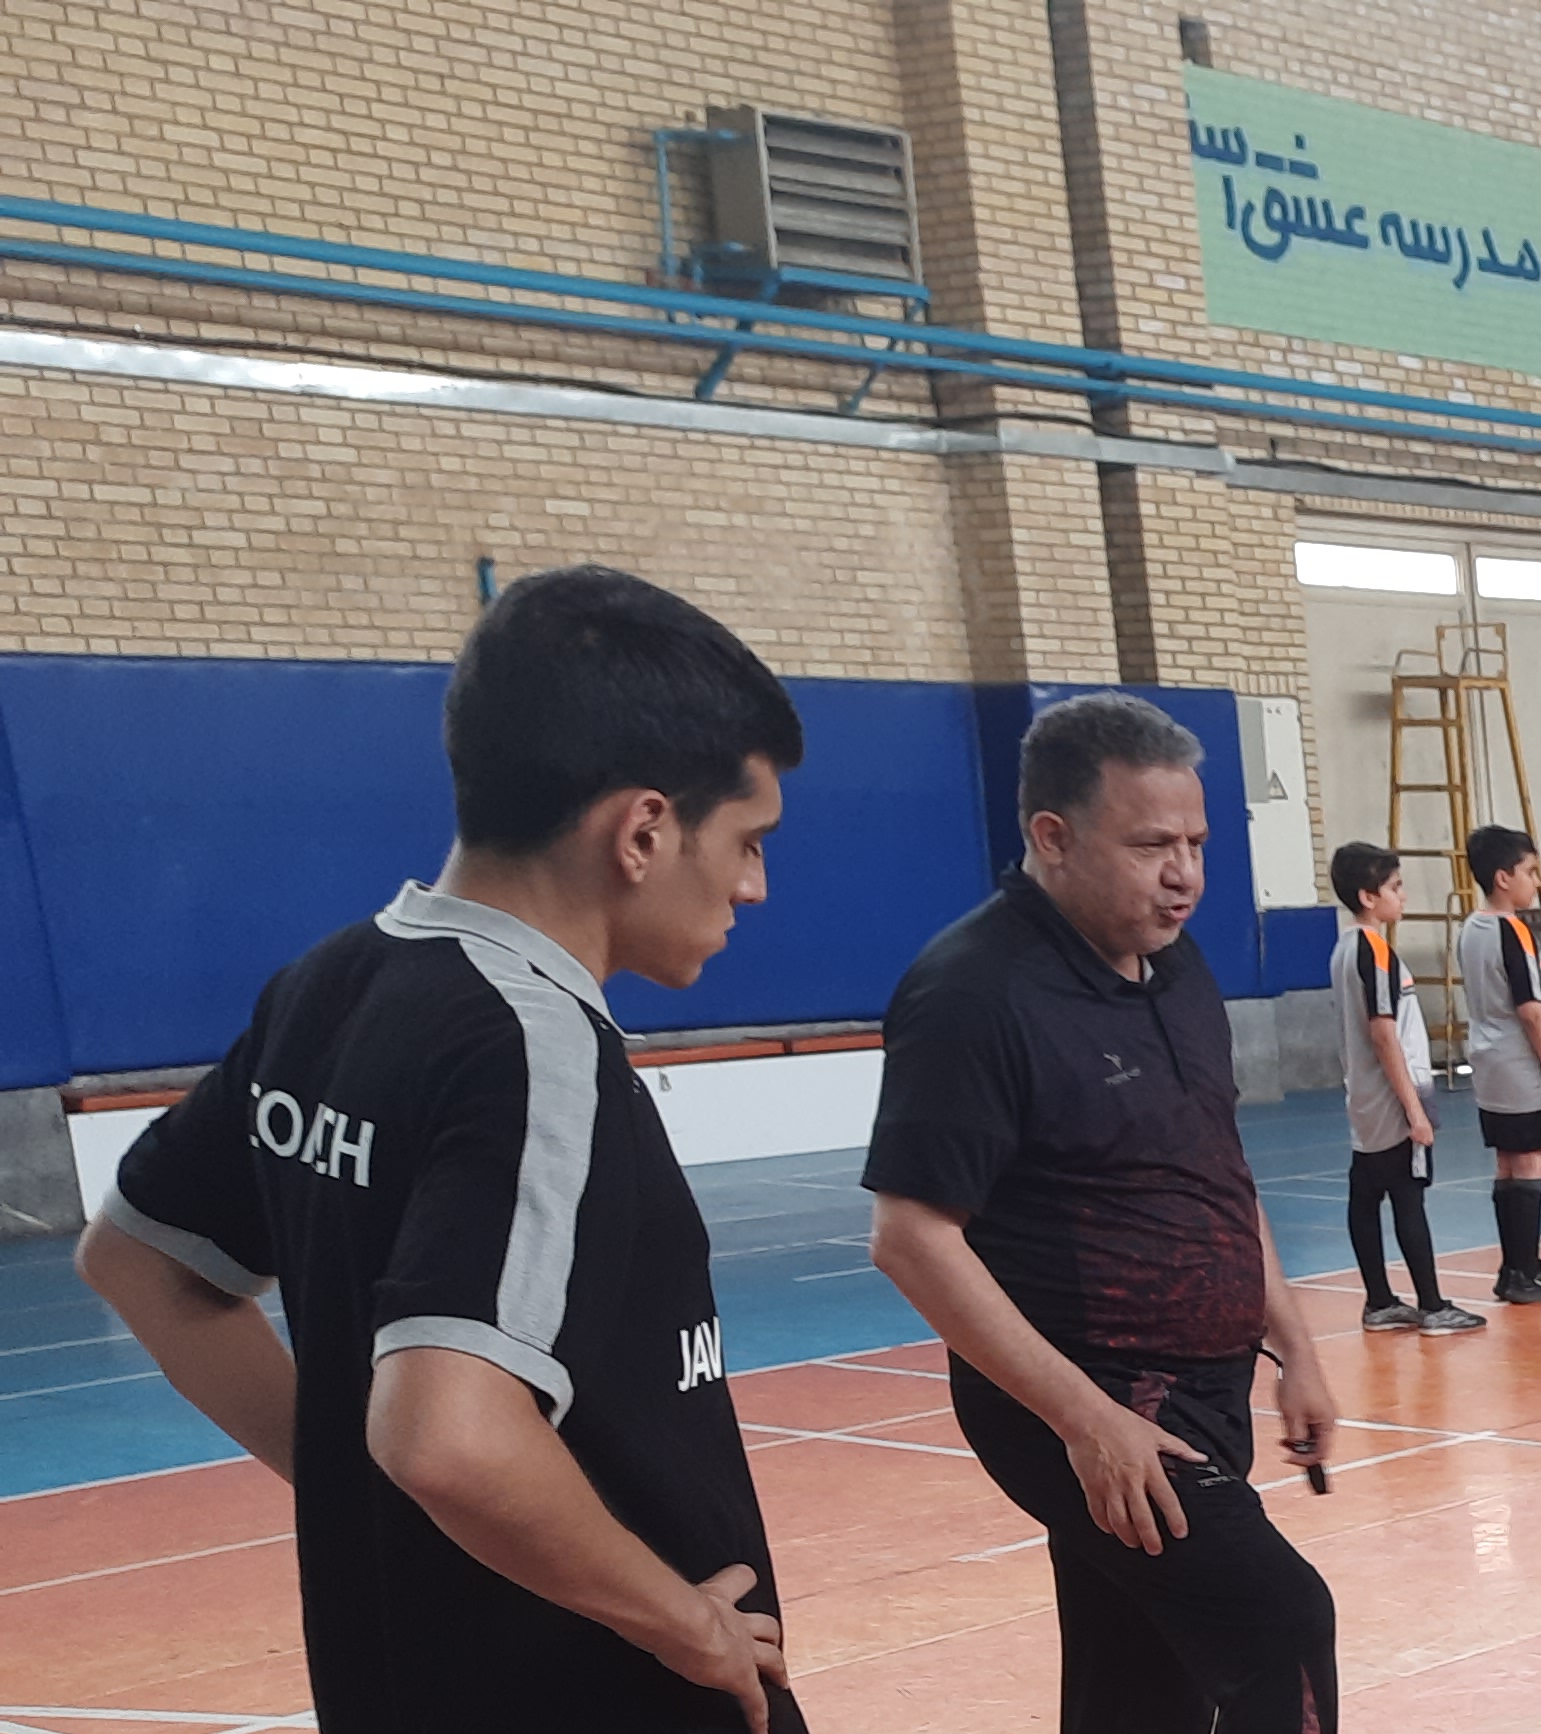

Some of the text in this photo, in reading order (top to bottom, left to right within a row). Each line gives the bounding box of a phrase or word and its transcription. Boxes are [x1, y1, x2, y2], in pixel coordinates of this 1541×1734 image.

[1241, 133, 1369, 263] عشق
[1380, 210, 1541, 291] مدرسه
[249, 1081, 376, 1188] OAH
